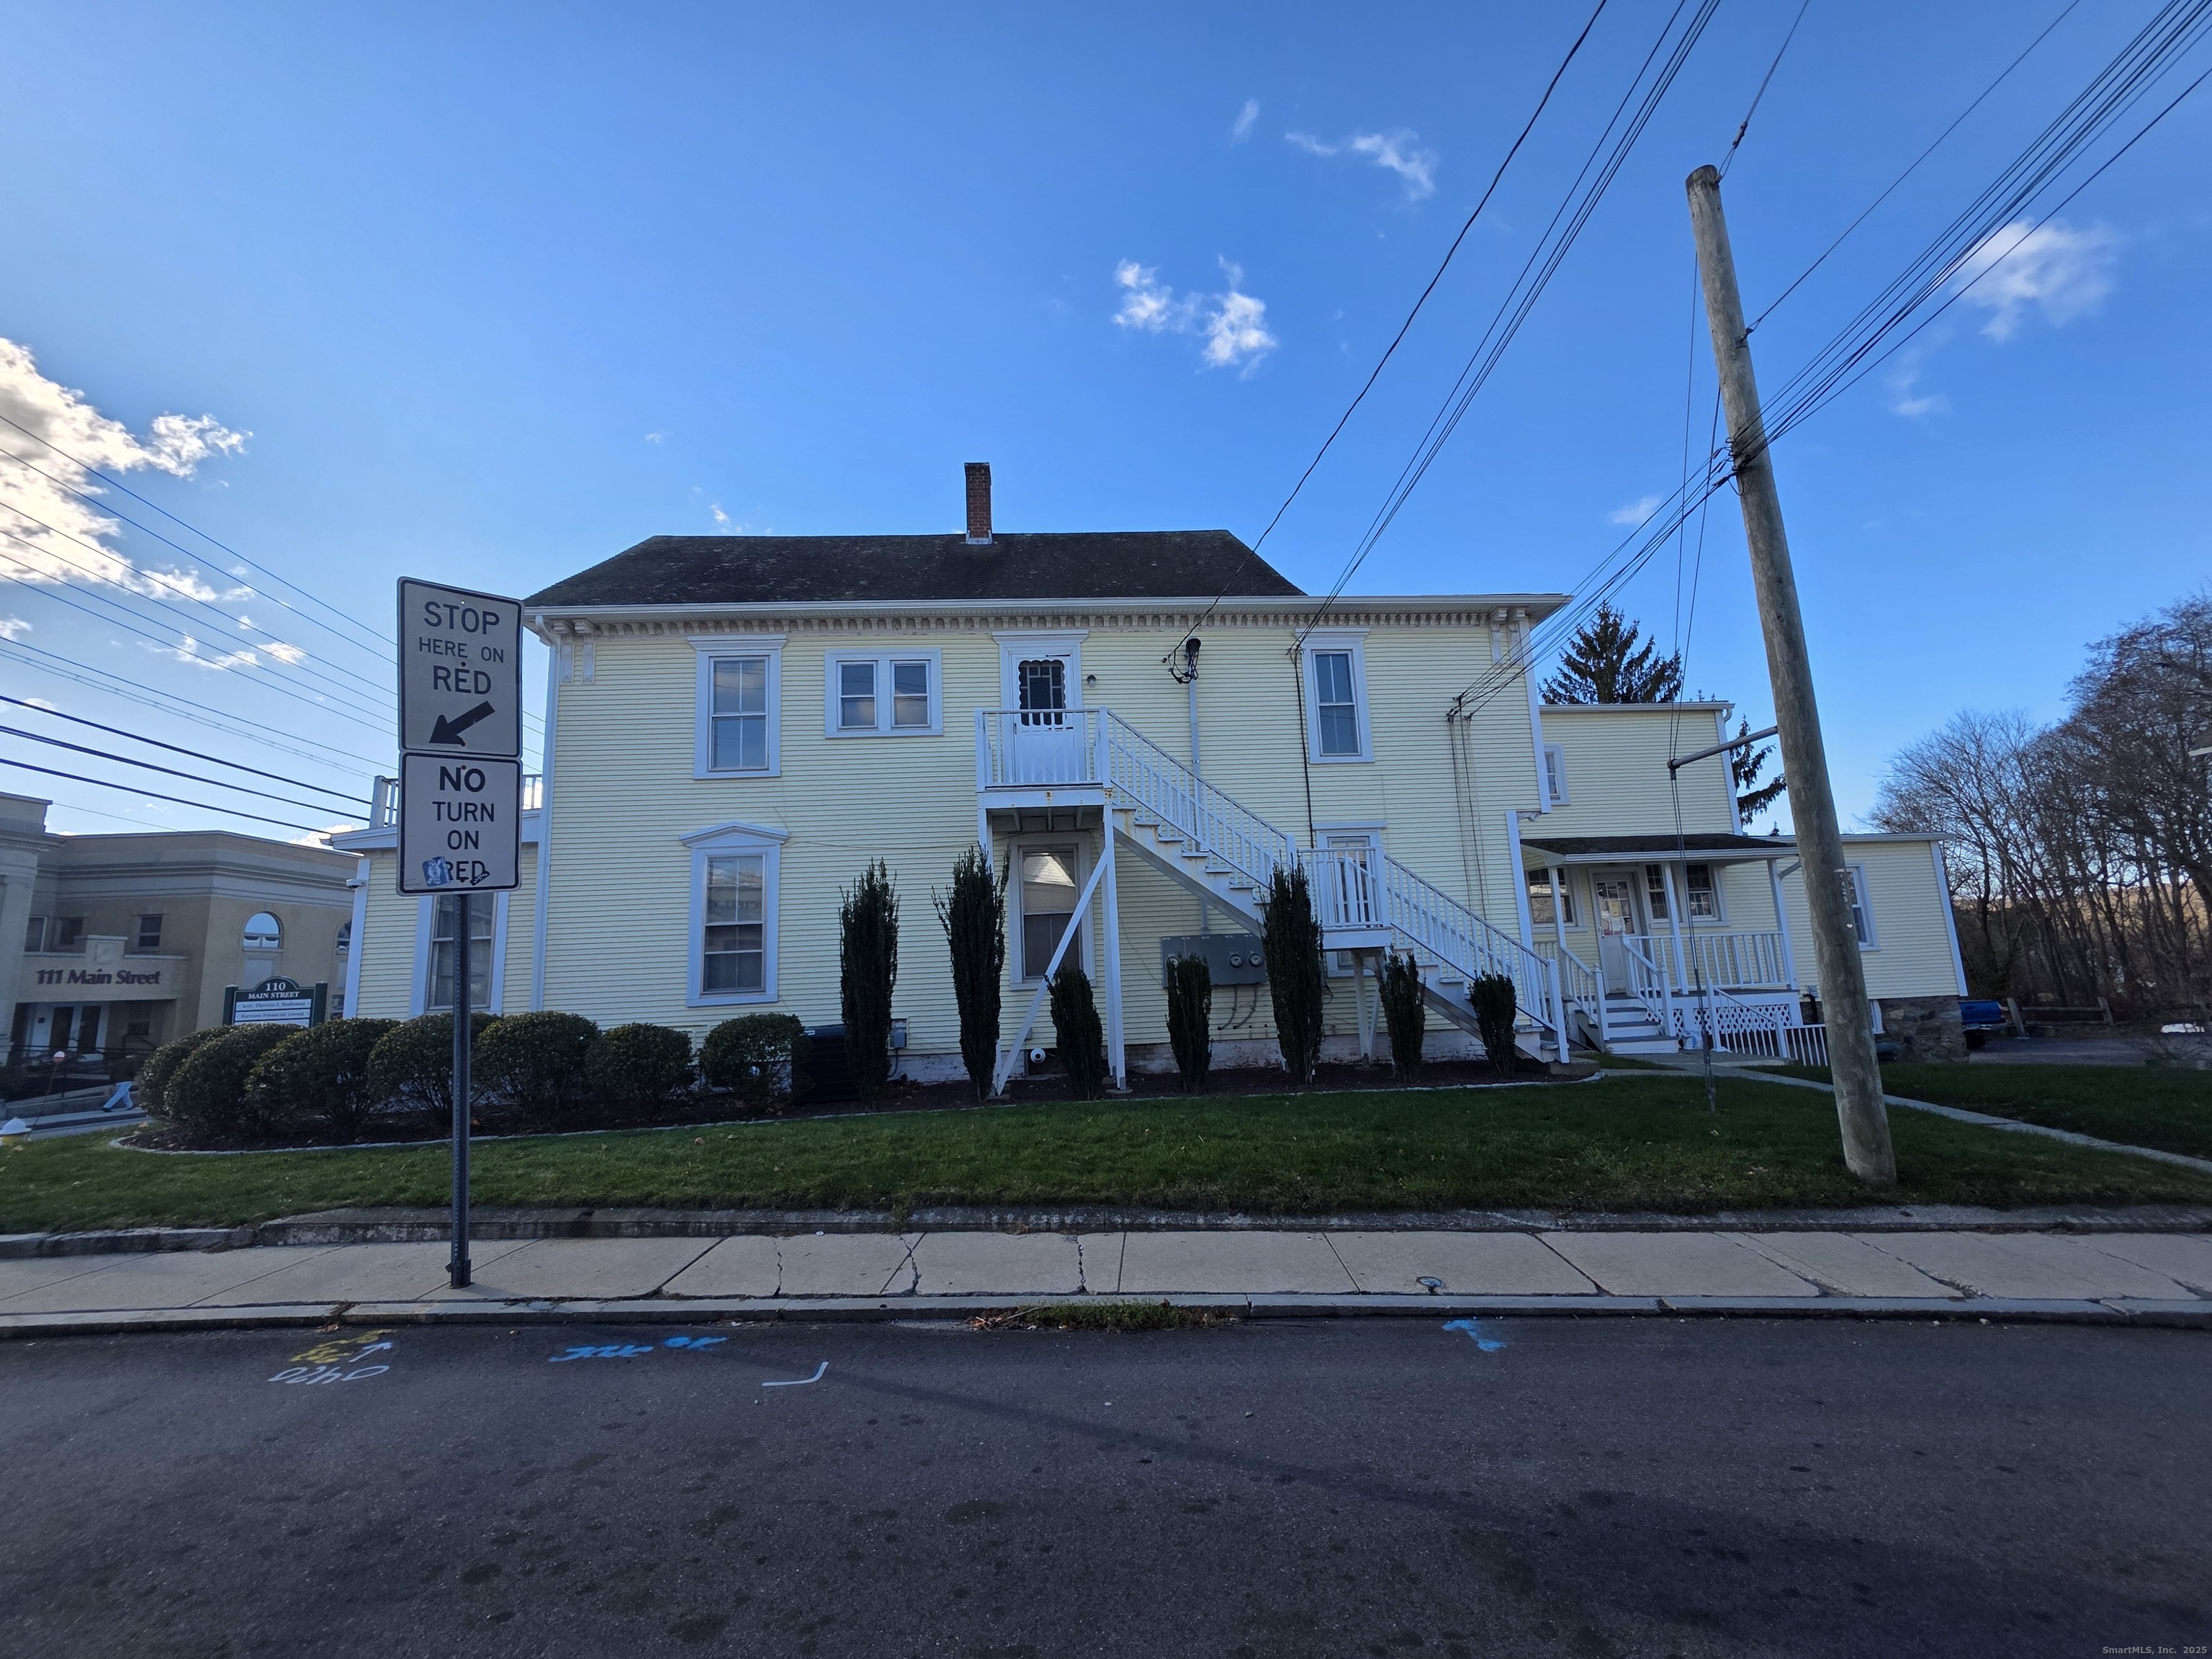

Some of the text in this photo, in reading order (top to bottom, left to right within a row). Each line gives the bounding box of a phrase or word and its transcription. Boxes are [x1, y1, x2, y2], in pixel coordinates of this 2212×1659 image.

[423, 601, 500, 635] STOP
[420, 637, 504, 663] HERE ON
[433, 665, 491, 694] RED
[439, 765, 486, 793] NO
[432, 801, 495, 822] TURN
[447, 830, 480, 850] ON
[430, 859, 441, 884] SUNOCO
[444, 860, 486, 881] RED
[36, 968, 161, 985] 111 Main Street
[266, 981, 286, 992] 110
